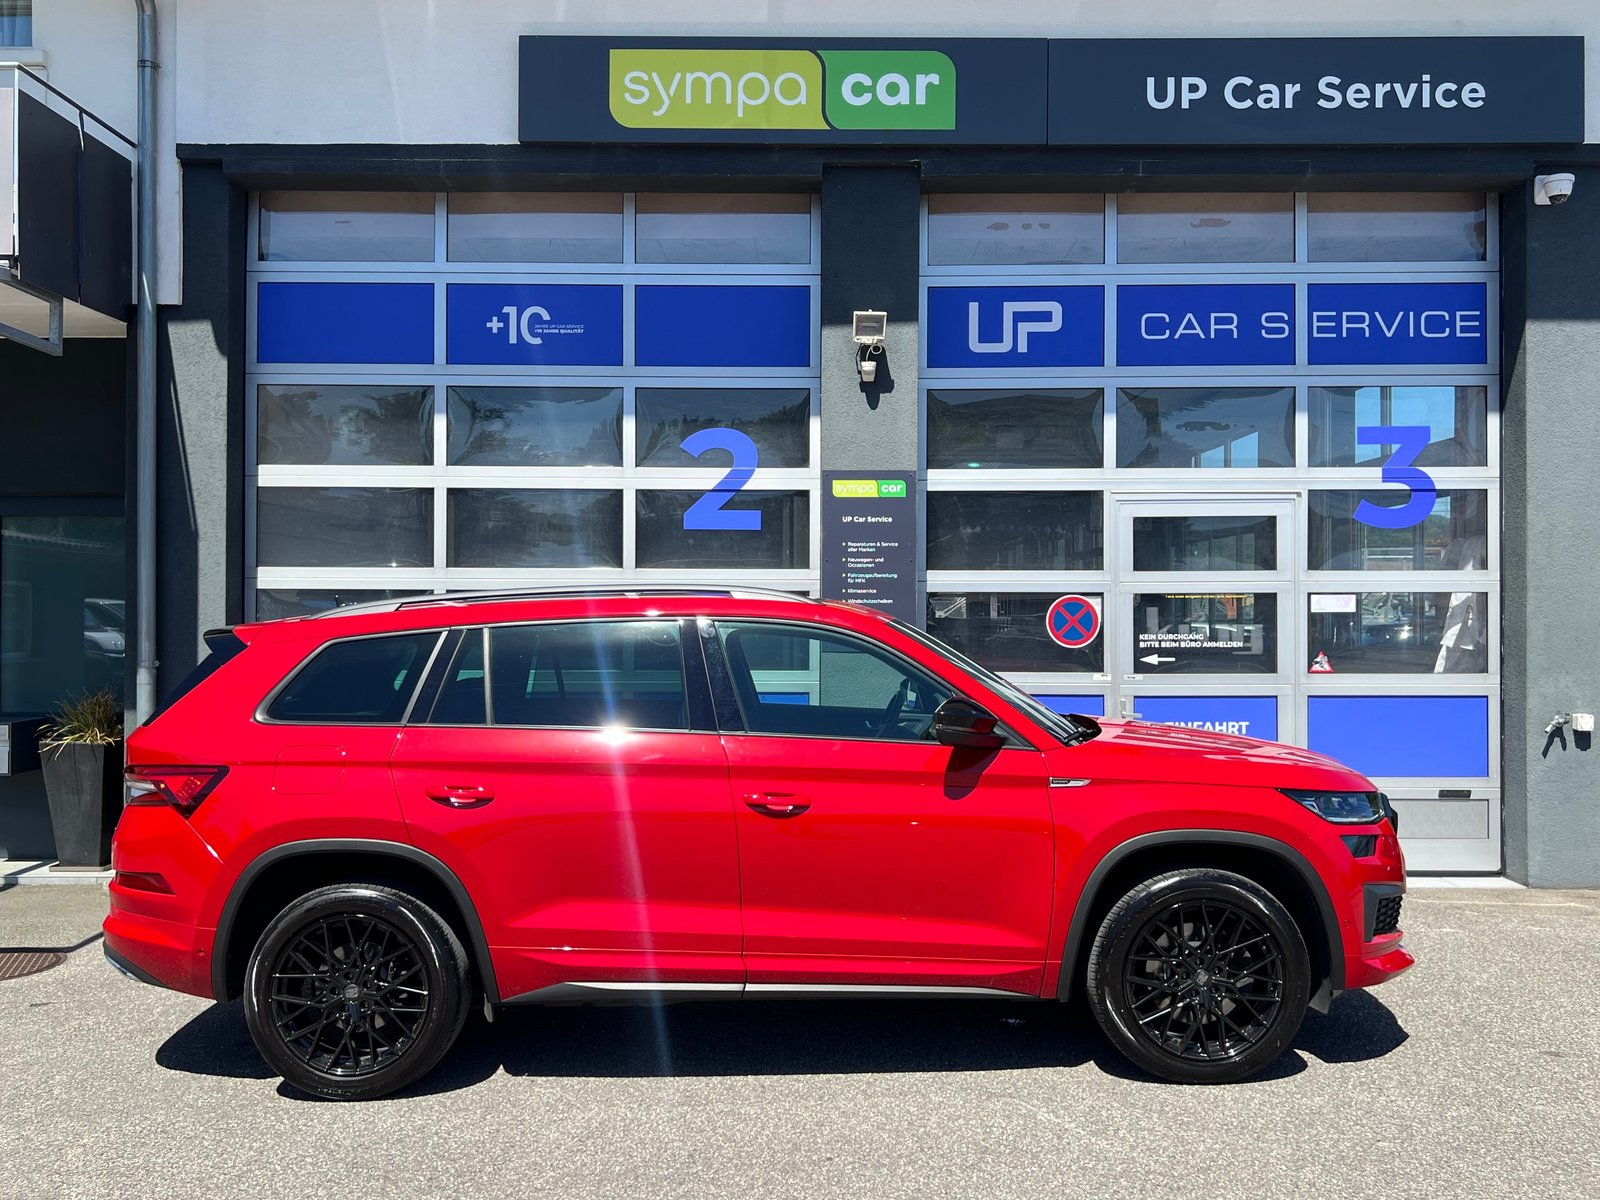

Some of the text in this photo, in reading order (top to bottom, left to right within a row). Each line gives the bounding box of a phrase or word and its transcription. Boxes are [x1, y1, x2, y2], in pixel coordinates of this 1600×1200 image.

[623, 70, 940, 118] sympa car
[1146, 74, 1487, 110] UP Car Service
[968, 301, 1063, 354] UP
[1140, 312, 1239, 340] CAR
[679, 427, 762, 531] 2
[834, 483, 903, 497] sympa car
[1353, 425, 1438, 530] 3
[1139, 633, 1204, 641] KEIN DURCHGANG
[1180, 640, 1202, 648] BÜRO
